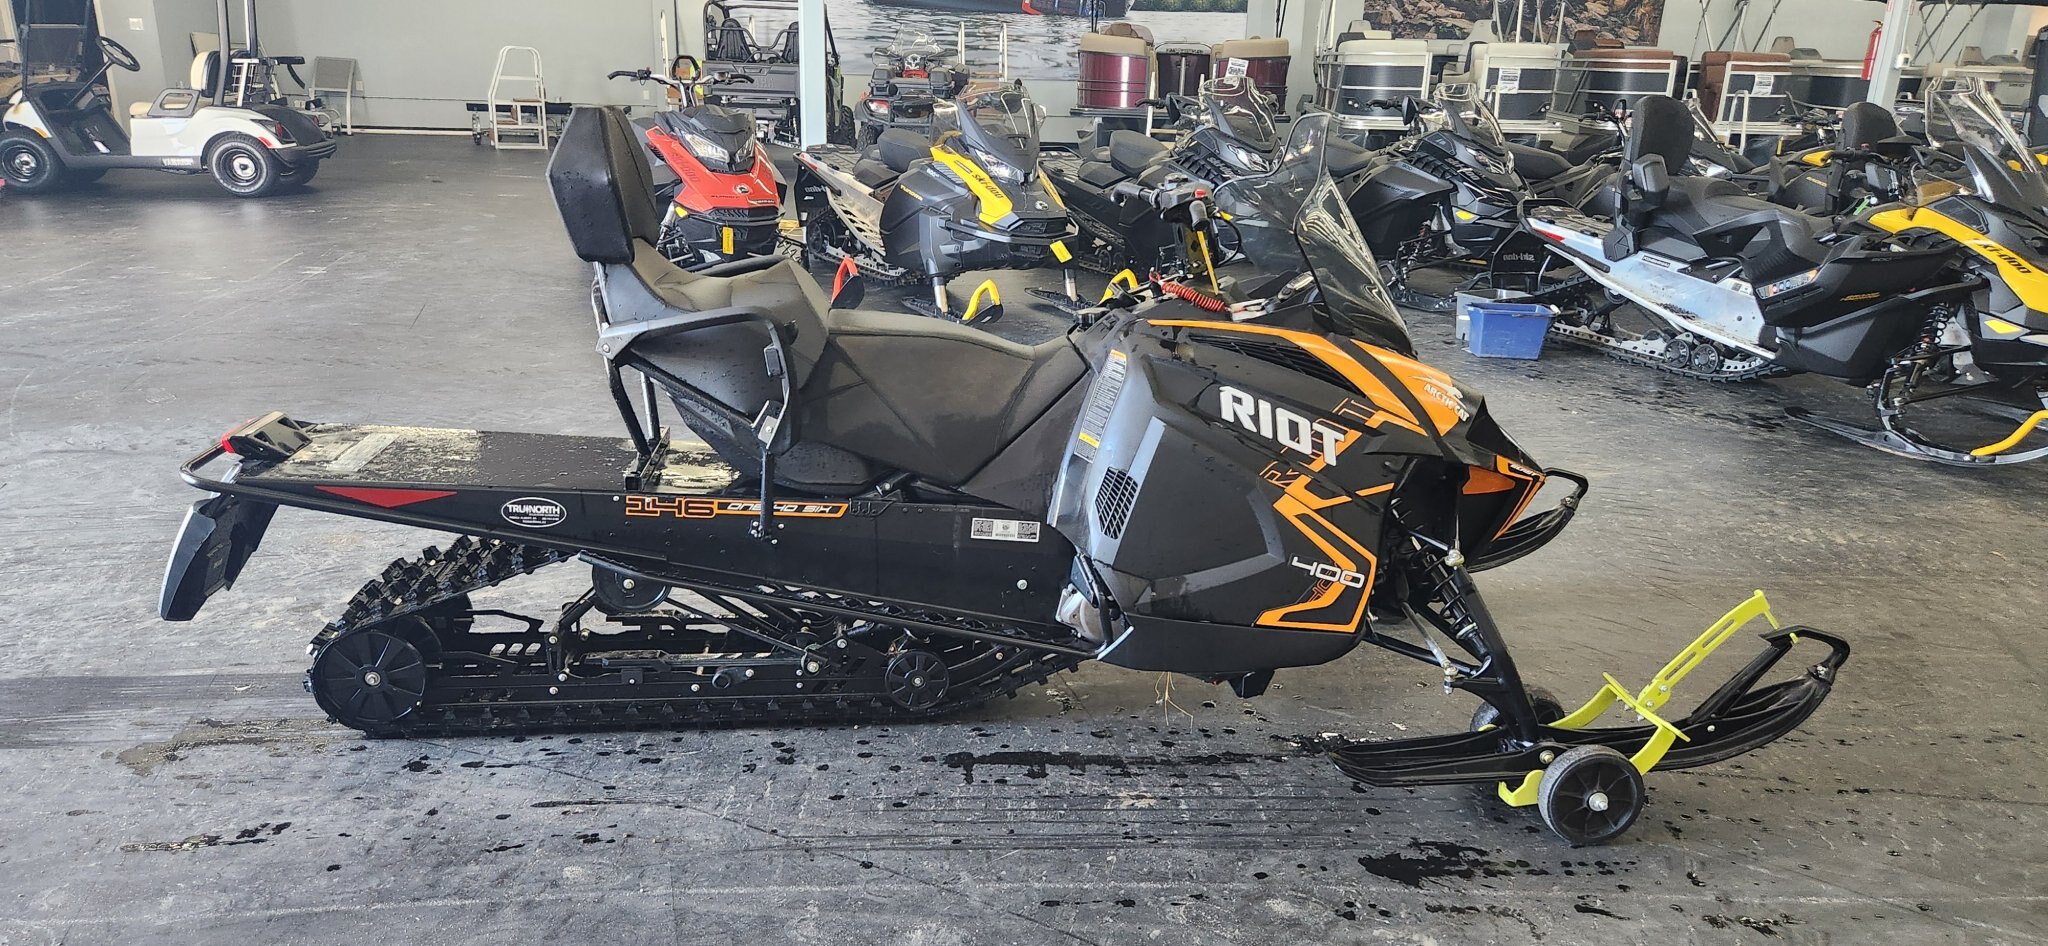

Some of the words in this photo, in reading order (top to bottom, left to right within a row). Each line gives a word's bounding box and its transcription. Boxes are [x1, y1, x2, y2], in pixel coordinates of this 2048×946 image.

[971, 172, 1005, 200] ski-doo
[1423, 382, 1455, 411] ARCTIC
[1453, 404, 1470, 422] CAT
[1218, 385, 1346, 467] RIOT
[625, 495, 717, 519] 146
[801, 503, 833, 514] SIX
[1291, 556, 1366, 589] 400
